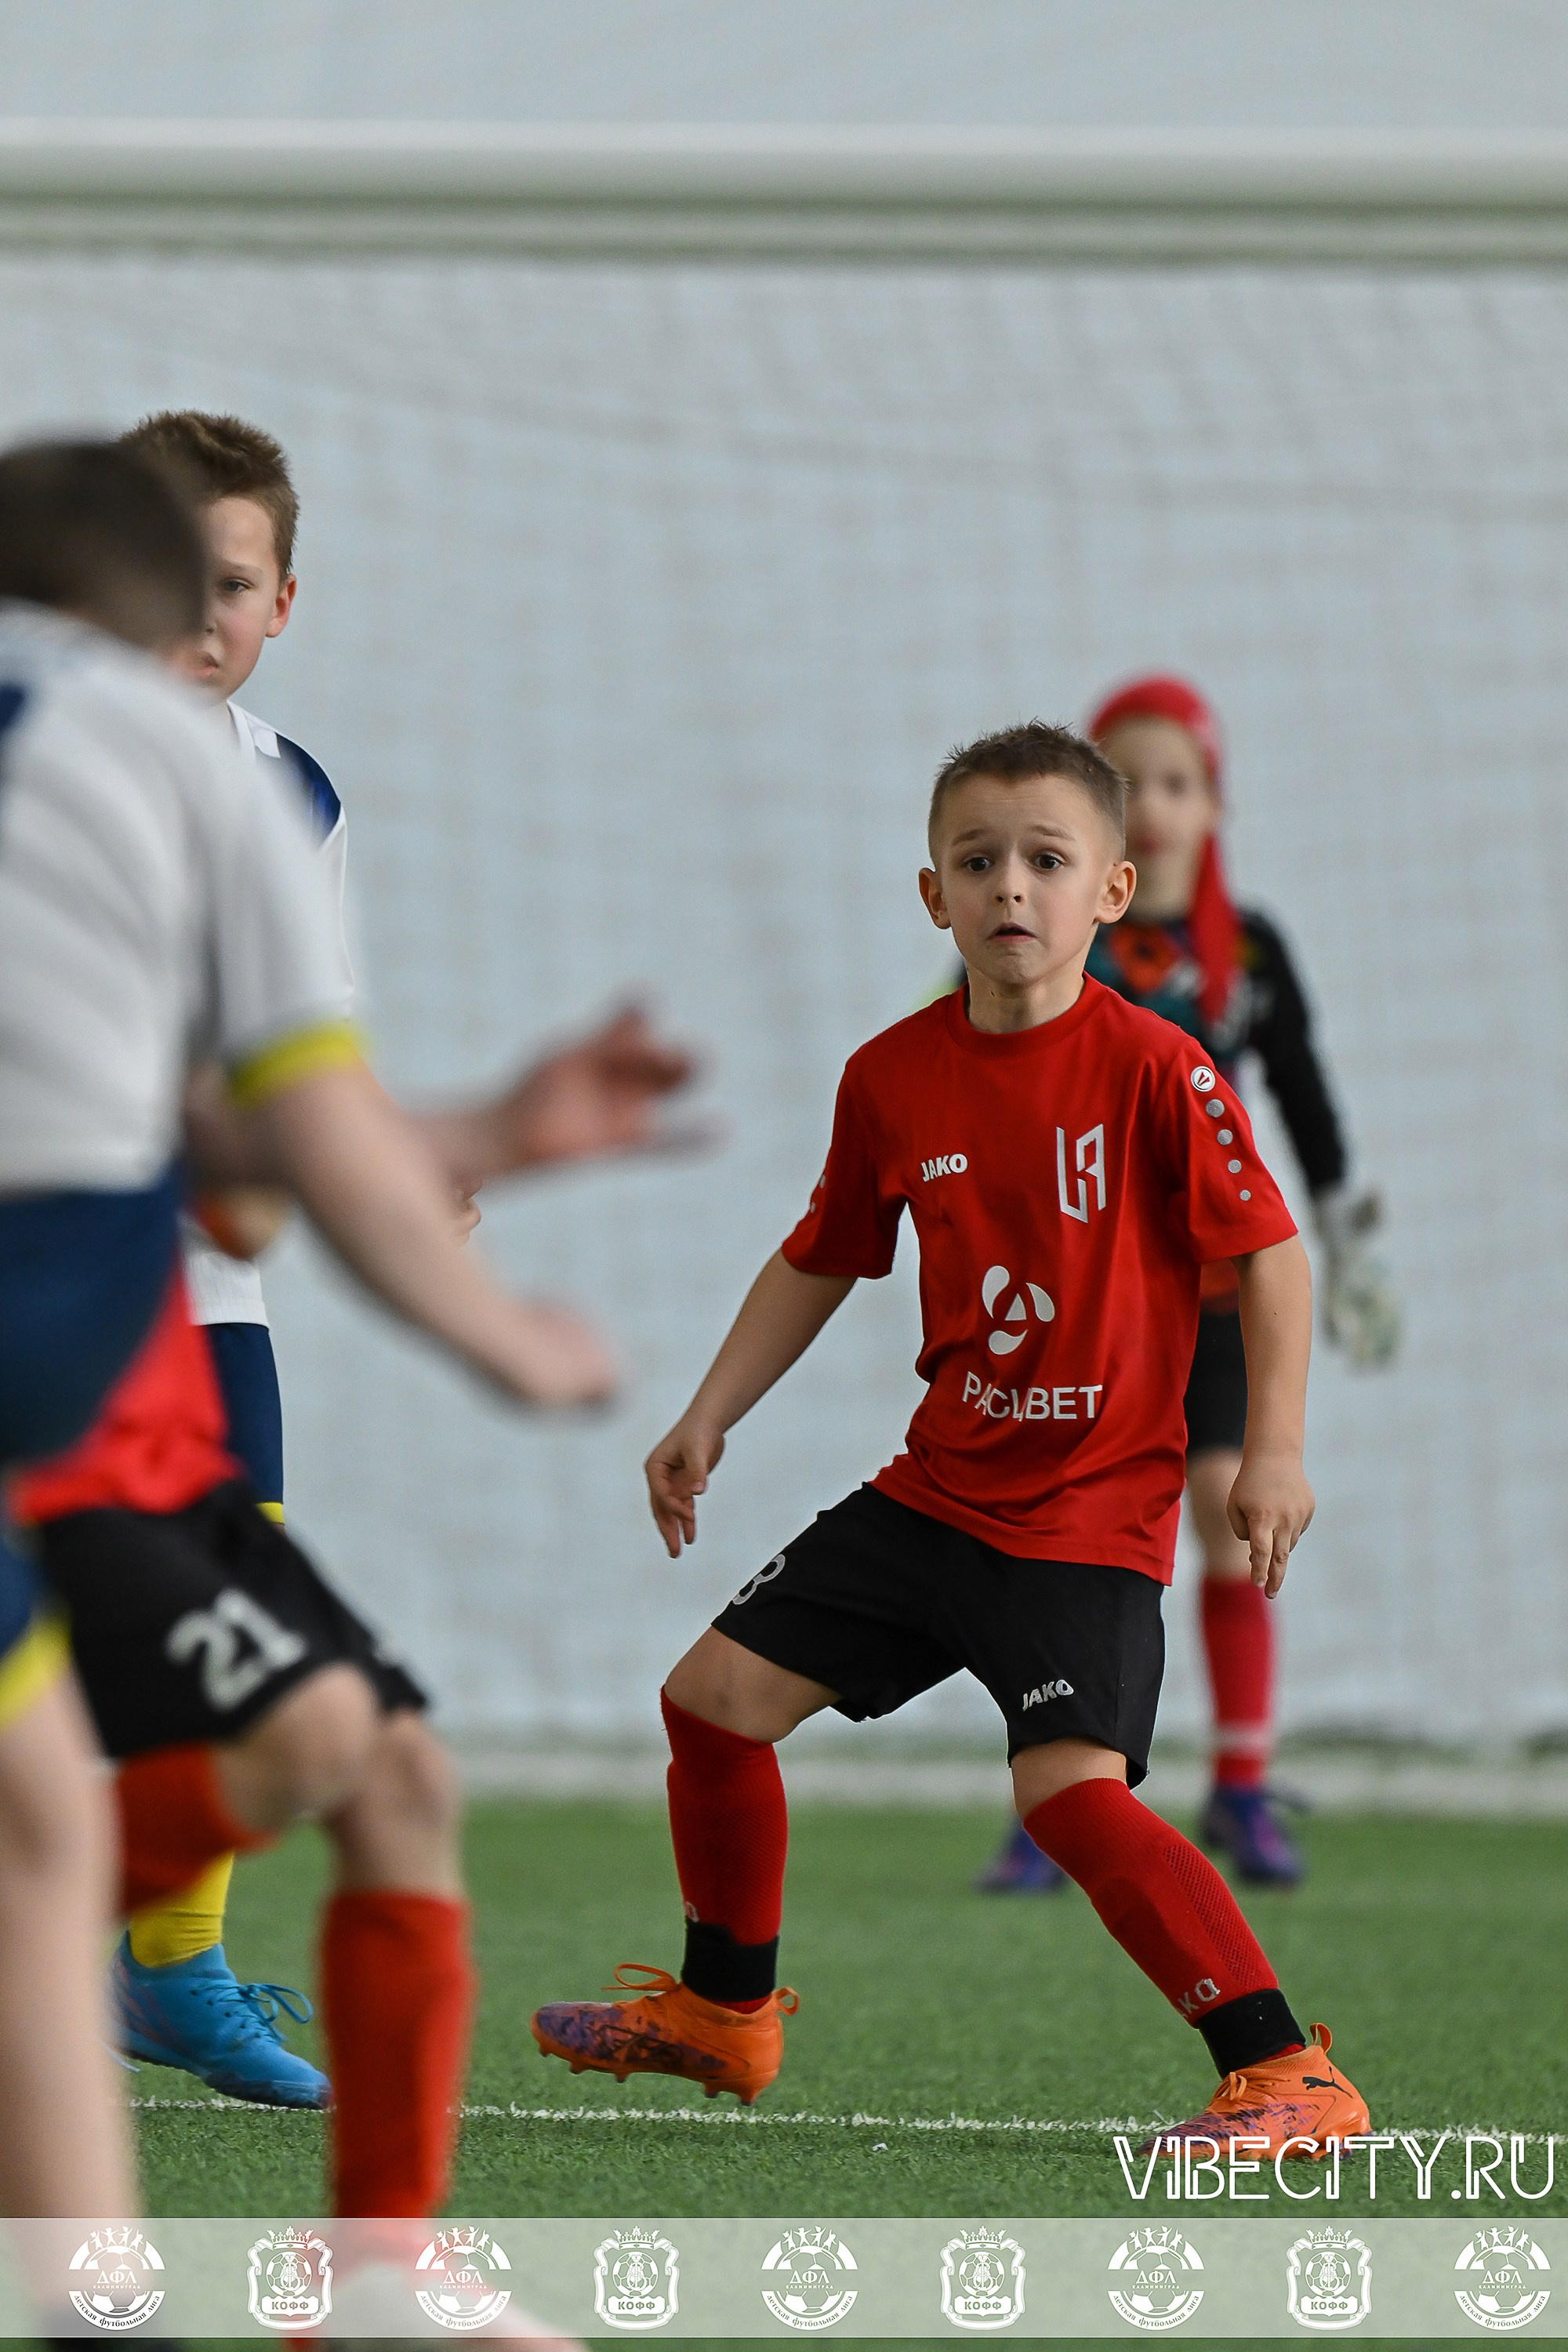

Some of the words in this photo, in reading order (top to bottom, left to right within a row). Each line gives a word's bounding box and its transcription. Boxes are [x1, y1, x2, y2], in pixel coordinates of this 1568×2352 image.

[920, 1153, 968, 1182] JAKO
[165, 1587, 308, 1712] 21
[1022, 1679, 1074, 1711] JAKO
